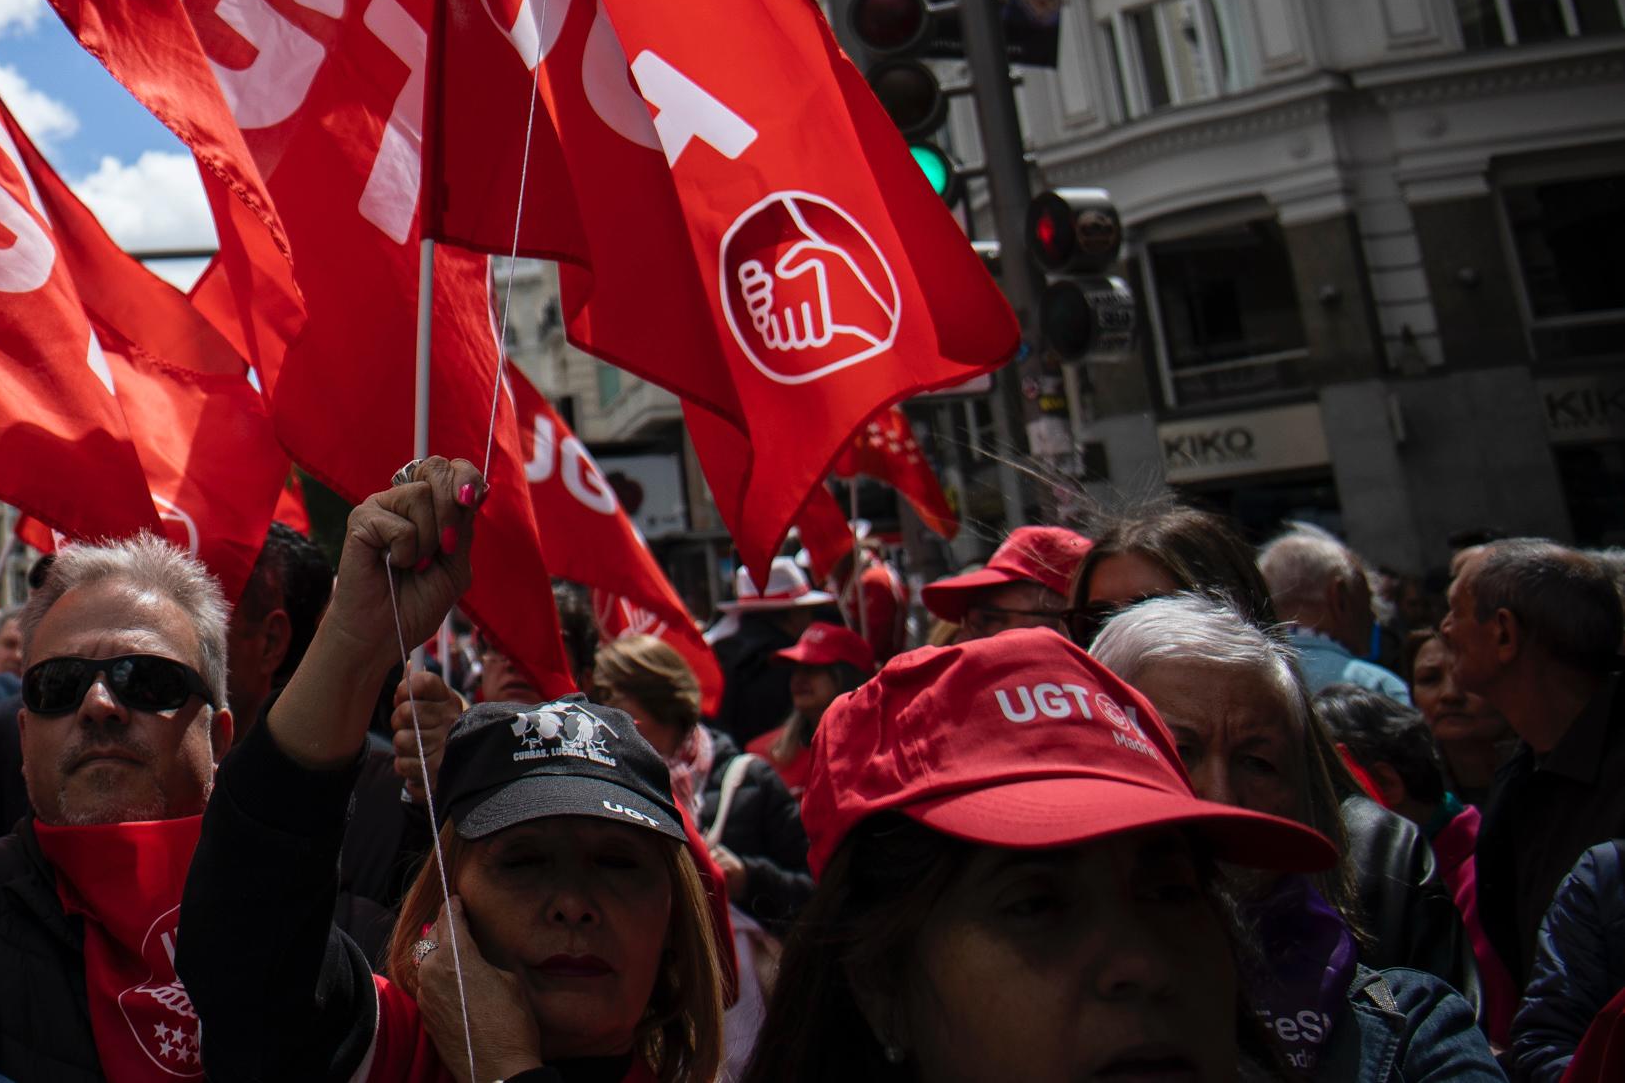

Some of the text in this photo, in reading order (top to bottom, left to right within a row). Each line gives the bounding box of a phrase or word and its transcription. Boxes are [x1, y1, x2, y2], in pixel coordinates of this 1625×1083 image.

[1163, 427, 1254, 462] KIKO
[994, 682, 1094, 724] UGT
[603, 800, 660, 827] UGT
